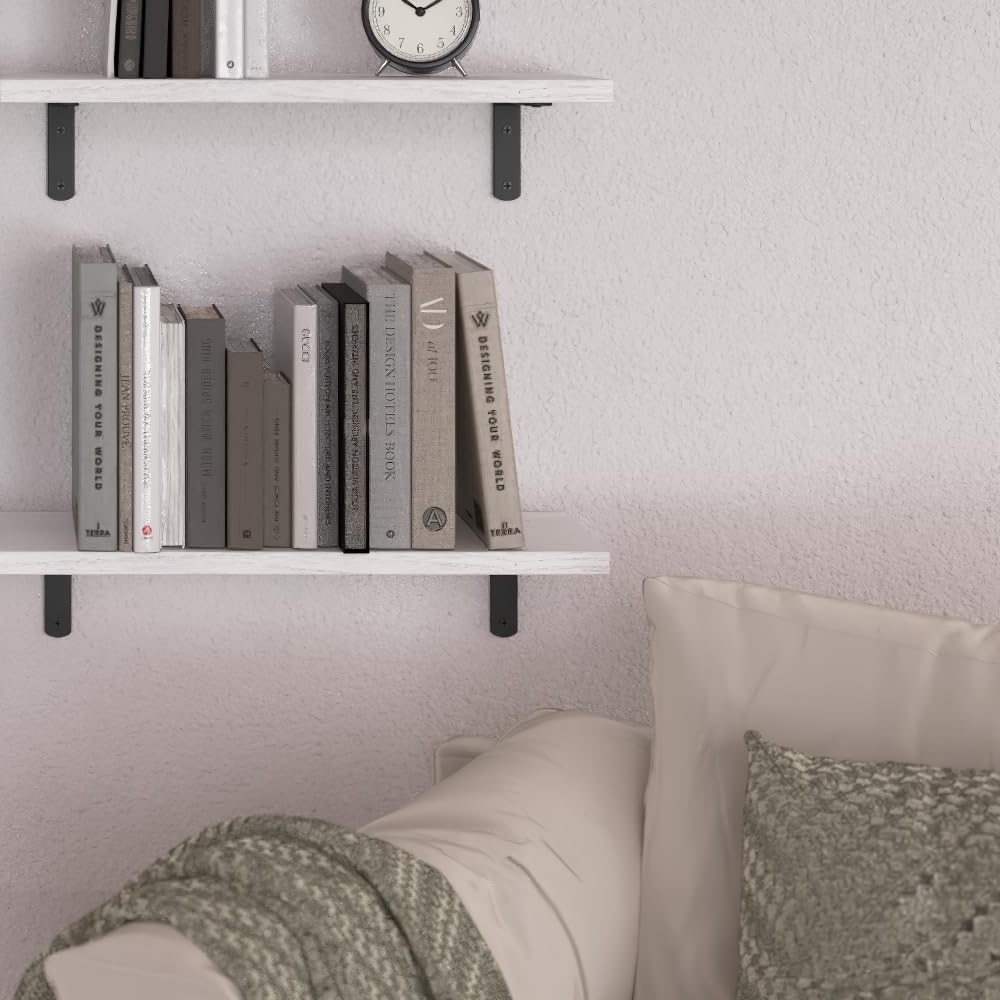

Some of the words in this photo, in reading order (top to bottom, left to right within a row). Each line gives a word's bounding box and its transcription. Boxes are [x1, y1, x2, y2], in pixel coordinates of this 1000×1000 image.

[378, 7, 385, 17] 9
[456, 7, 462, 17] 3
[384, 25, 390, 35] 8
[399, 38, 405, 48] 7
[437, 38, 444, 48] 5
[450, 25, 456, 35] 4
[417, 43, 424, 54] 6
[385, 293, 396, 322] THE
[385, 327, 396, 377] DESIGN
[478, 336, 495, 403] DESIGNING
[121, 375, 130, 404] JEAN
[385, 383, 396, 436] HOTELS
[488, 409, 499, 441] YOUR
[385, 443, 396, 480] BOOK
[492, 452, 505, 491] WORLD
